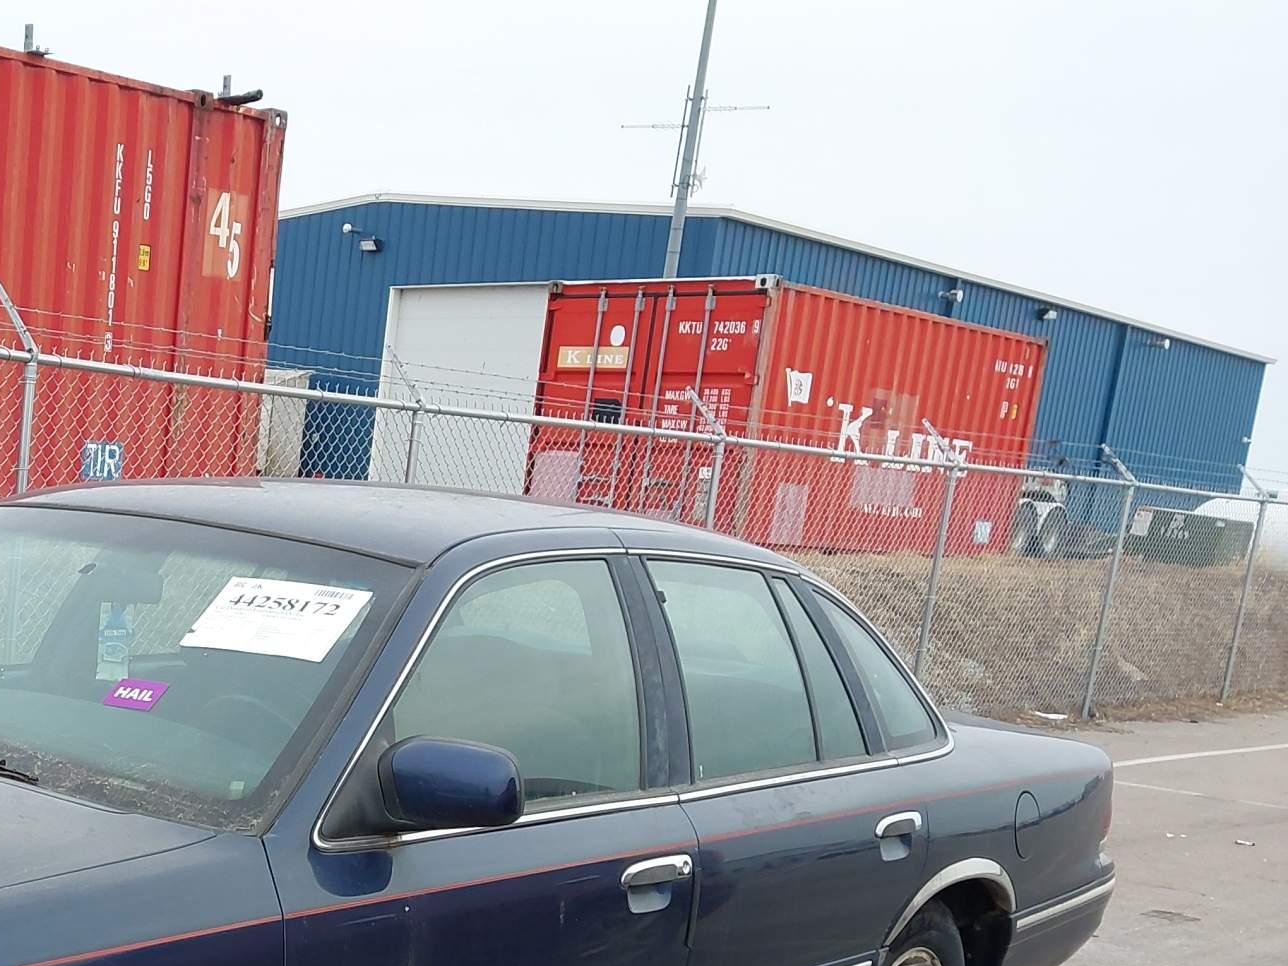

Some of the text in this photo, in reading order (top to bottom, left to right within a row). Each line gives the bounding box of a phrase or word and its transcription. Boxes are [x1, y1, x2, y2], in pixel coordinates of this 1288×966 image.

[113, 143, 124, 214] KKFU
[209, 191, 242, 278] 45
[107, 220, 119, 326] 911801
[678, 320, 761, 335] KKTU 742036 9
[710, 337, 732, 351] 22G
[586, 353, 624, 365] LINE
[87, 443, 120, 478] TIR
[229, 593, 341, 616] 44258172
[114, 686, 153, 702] HAIL
